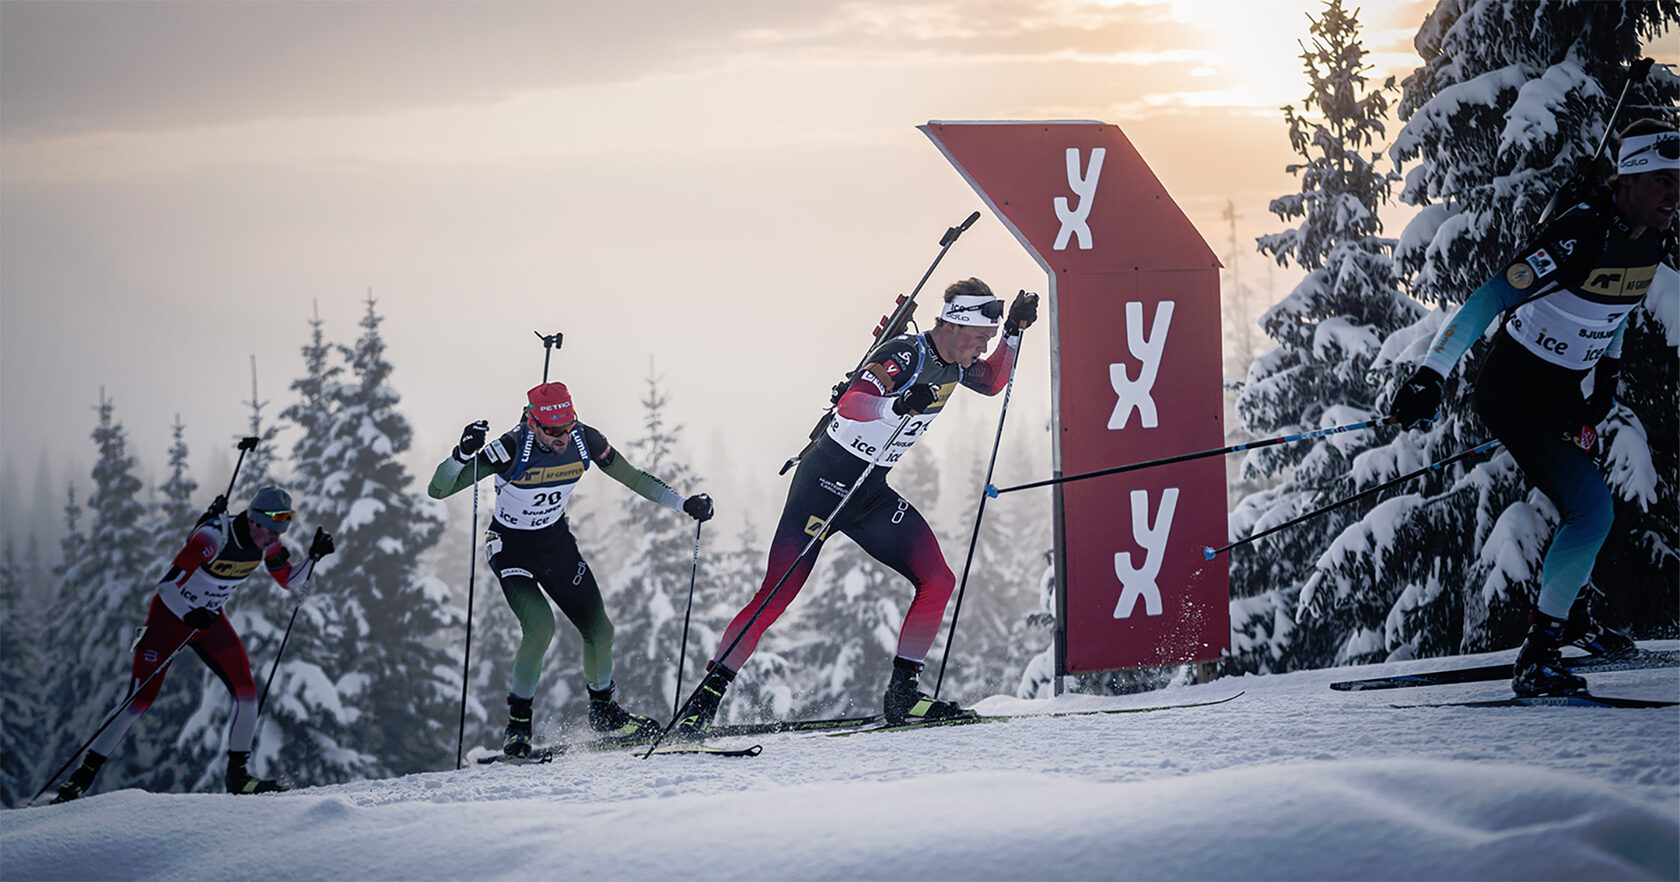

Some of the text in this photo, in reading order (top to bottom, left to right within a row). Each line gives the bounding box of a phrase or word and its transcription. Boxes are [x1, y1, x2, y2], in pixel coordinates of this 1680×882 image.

[1535, 327, 1569, 356] ice
[571, 430, 589, 460] Lumar
[851, 435, 877, 456] ice
[531, 491, 562, 507] 20
[499, 507, 518, 525] ice
[530, 517, 550, 528] ice
[180, 588, 198, 603] ice
